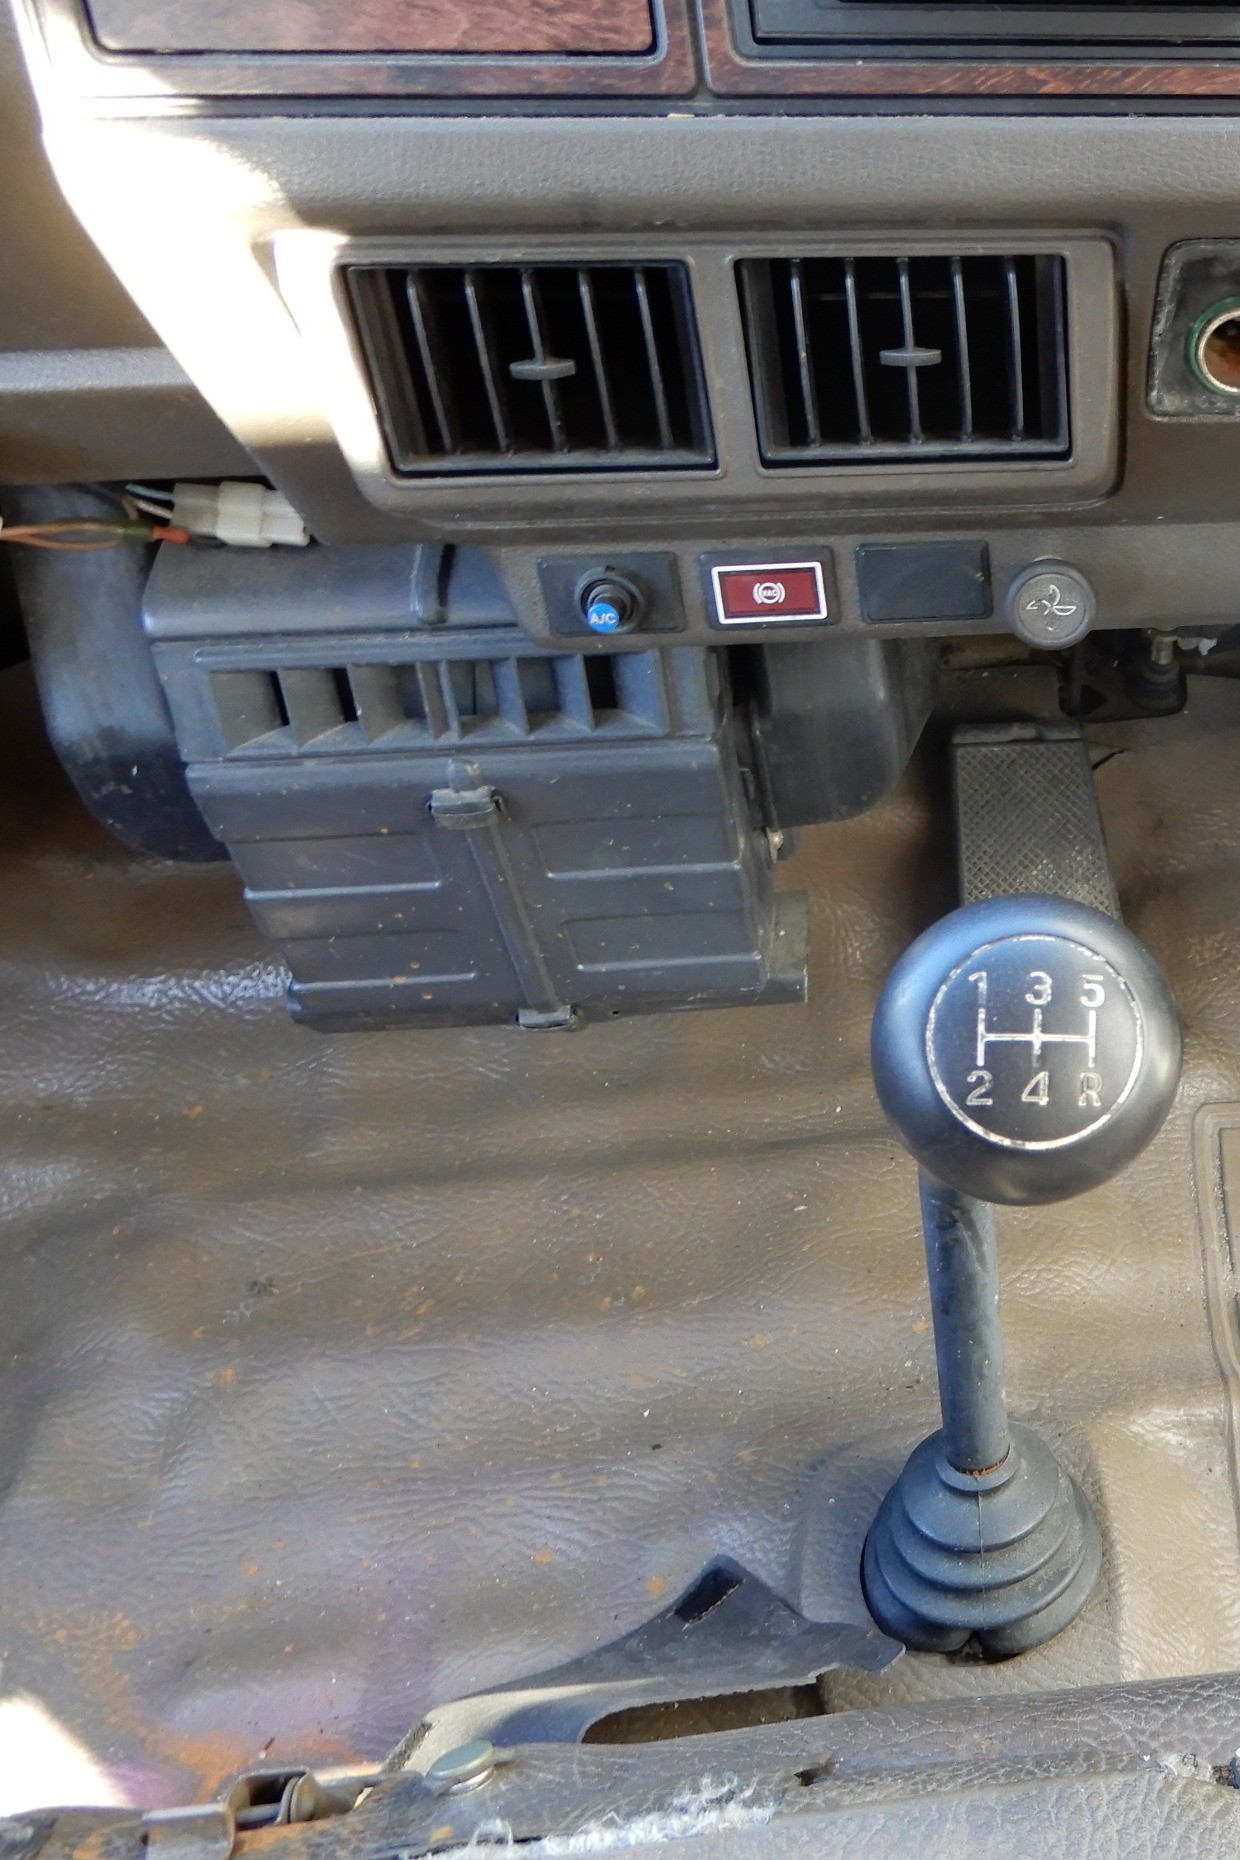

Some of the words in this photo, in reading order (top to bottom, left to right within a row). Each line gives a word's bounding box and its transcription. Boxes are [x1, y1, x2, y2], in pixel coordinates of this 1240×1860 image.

[589, 612, 617, 625] A/C
[968, 971, 988, 1005] 1
[1024, 971, 1052, 1005] 3
[1080, 974, 1105, 1008] 5
[966, 1070, 993, 1106] 2
[1021, 1071, 1050, 1106] 4
[1078, 1071, 1103, 1106] R
